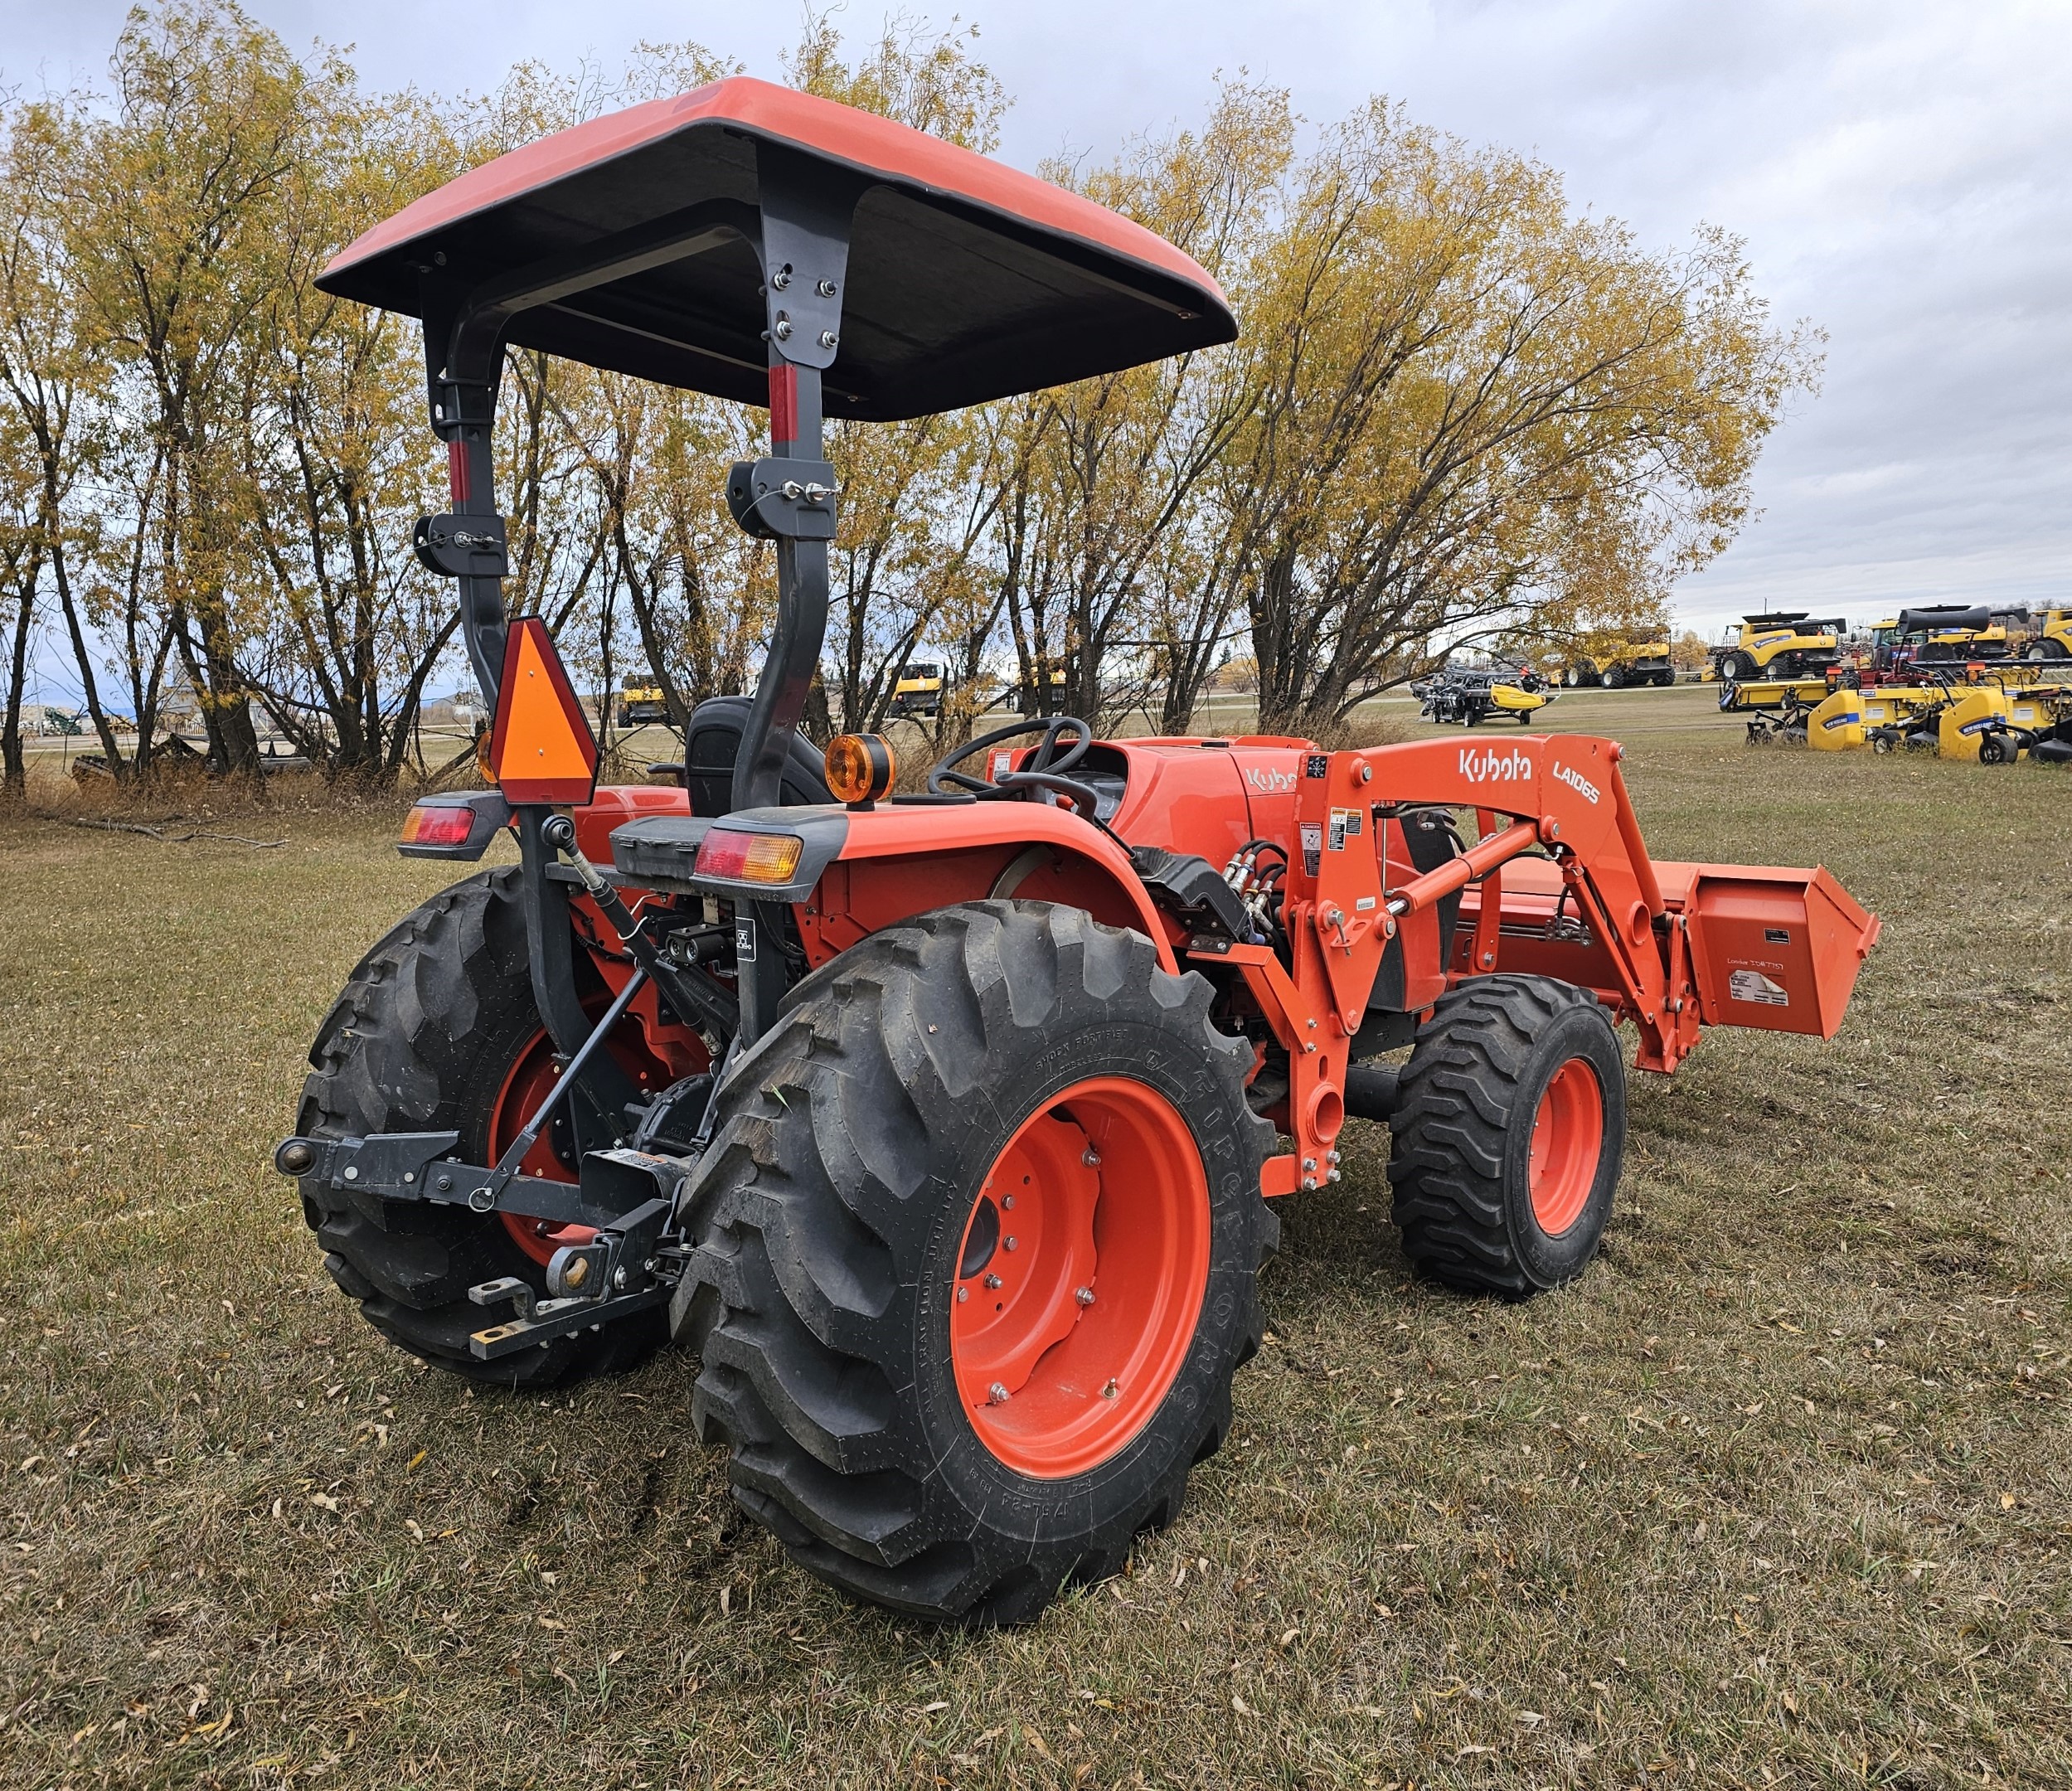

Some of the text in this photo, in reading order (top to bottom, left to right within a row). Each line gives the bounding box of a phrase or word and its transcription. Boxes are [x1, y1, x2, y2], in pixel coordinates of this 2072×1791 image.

[1458, 748, 1531, 783] Kubota
[1552, 760, 1601, 804] LA1065
[1034, 1028, 1129, 1072] SHOCK FORTIFIED
[917, 1270, 934, 1370] TRACTION
